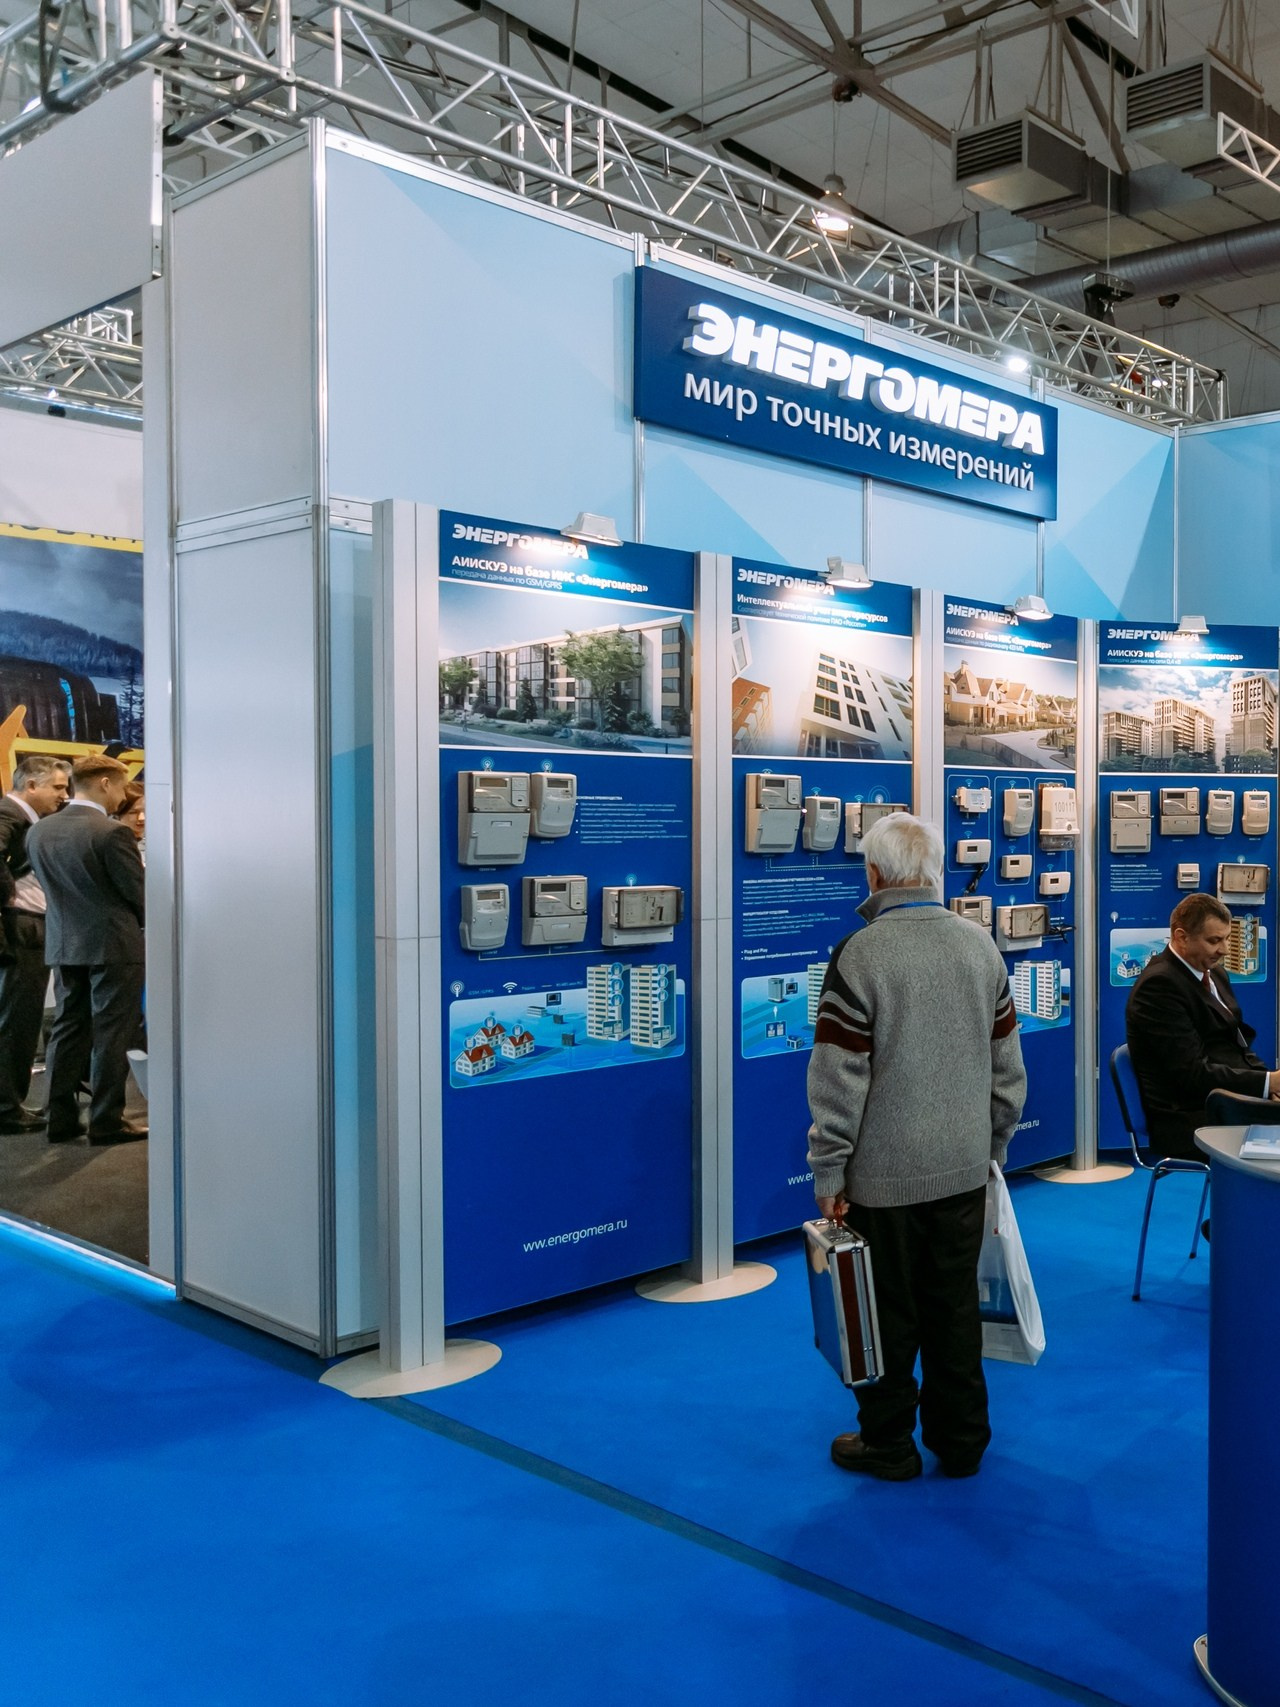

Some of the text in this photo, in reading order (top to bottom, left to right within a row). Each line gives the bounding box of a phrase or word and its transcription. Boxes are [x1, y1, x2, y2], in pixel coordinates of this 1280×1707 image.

[683, 302, 1046, 455] ЭНЕРГОМЕРА
[684, 373, 1034, 491] мир точных измерений
[451, 523, 589, 560] ЭНЕРГОМЕРА
[451, 555, 508, 572] АИИСКУЭ
[509, 565, 523, 575] на
[525, 565, 551, 579] базе
[737, 568, 836, 596] ЭНЕРГОМЕРА
[946, 603, 1019, 626] ЭНЕРГОМЕРА
